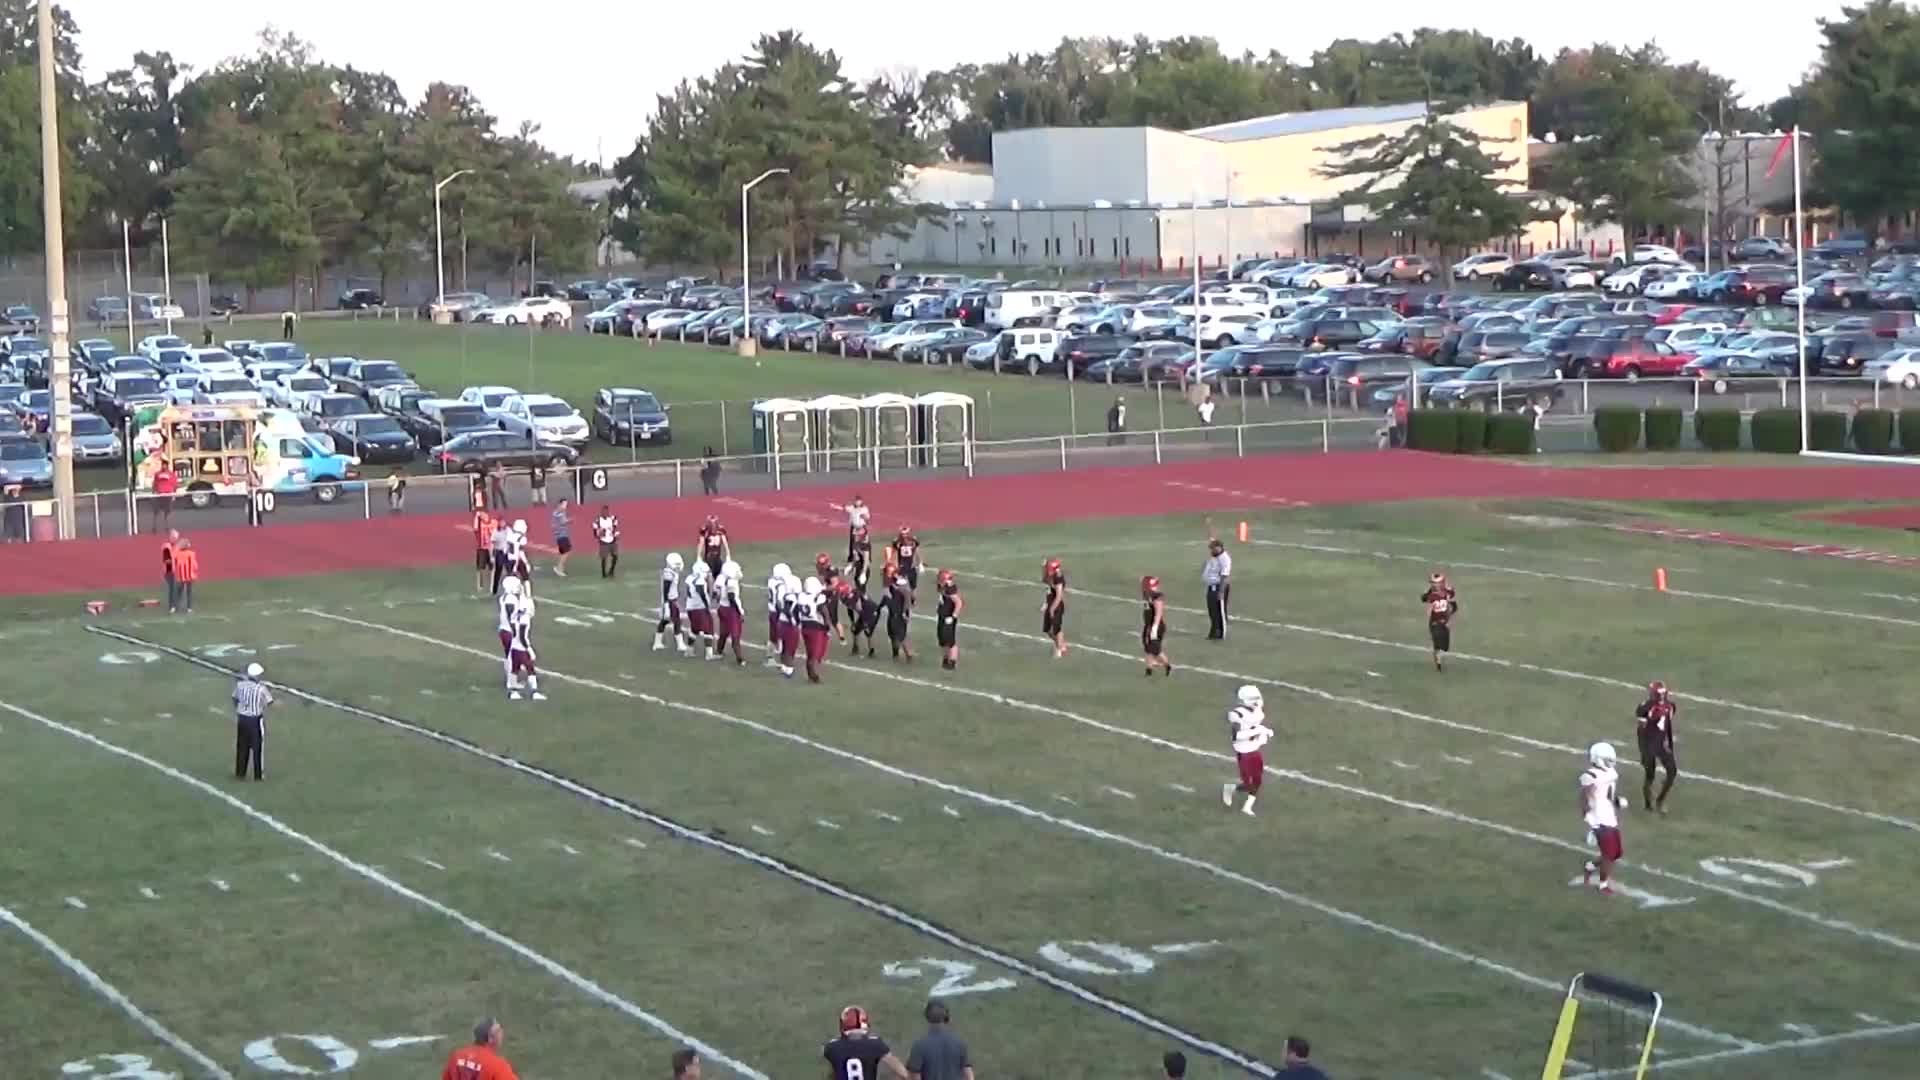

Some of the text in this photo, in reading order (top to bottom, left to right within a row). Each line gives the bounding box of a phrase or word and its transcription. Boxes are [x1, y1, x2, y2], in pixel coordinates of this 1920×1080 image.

[593, 469, 606, 488] G
[256, 492, 274, 511] 10
[882, 940, 1154, 998] 20
[846, 1057, 864, 1080] 8
